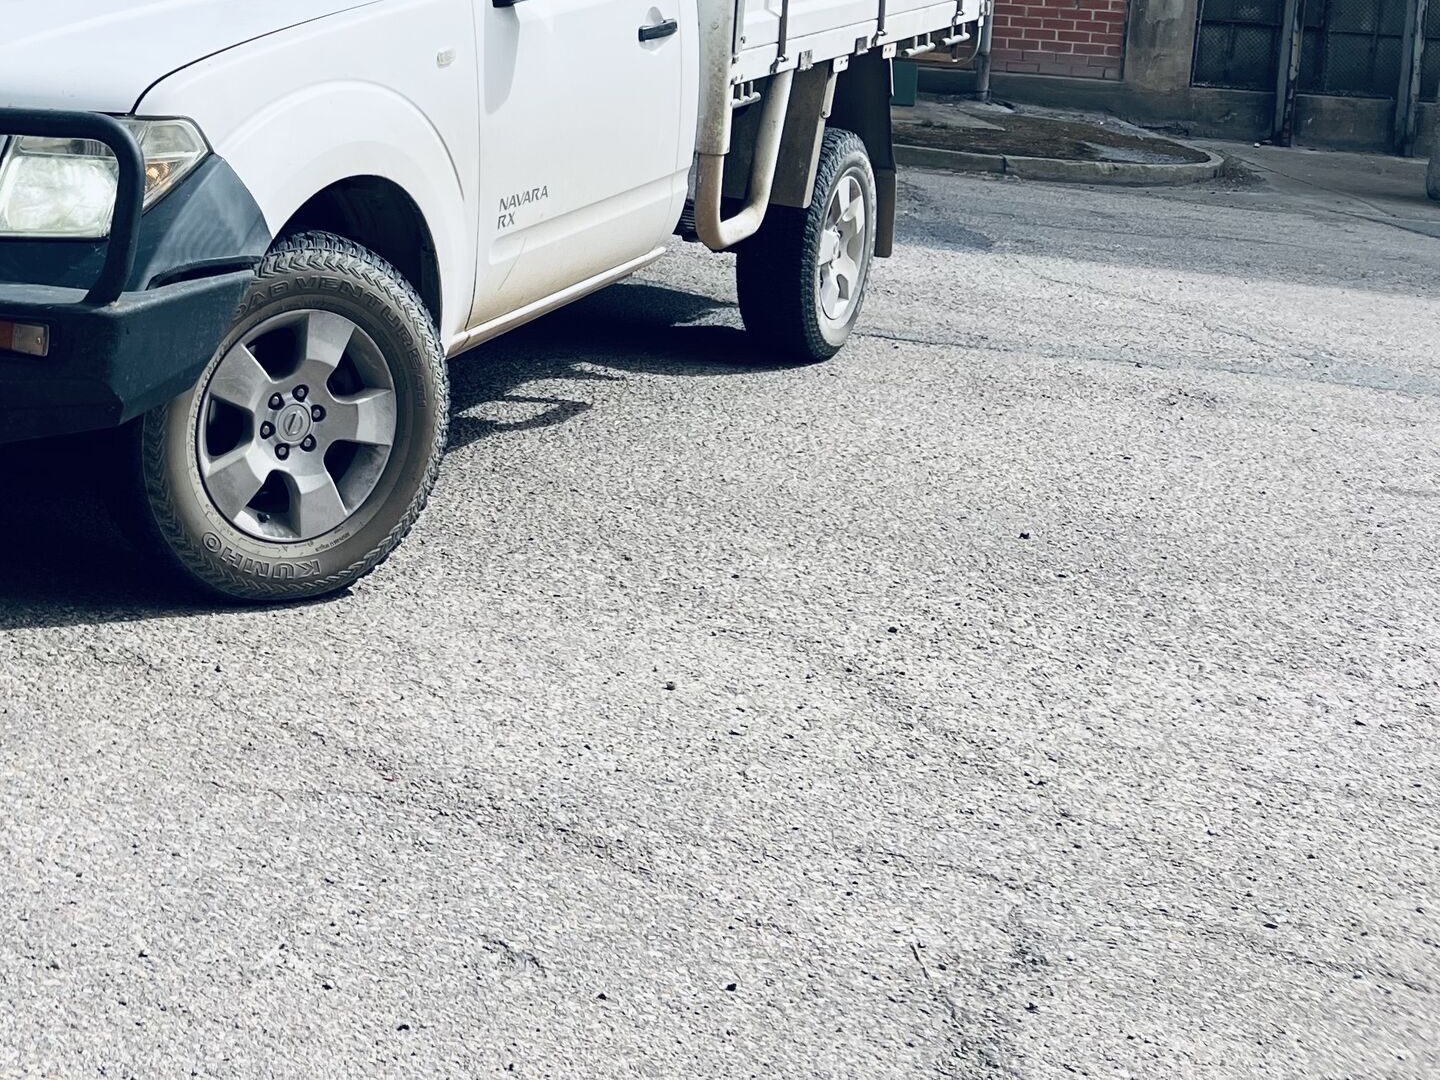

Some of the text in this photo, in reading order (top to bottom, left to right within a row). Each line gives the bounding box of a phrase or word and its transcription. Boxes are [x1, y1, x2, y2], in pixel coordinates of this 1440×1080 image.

[499, 185, 548, 212] NAVARA
[497, 211, 515, 230] RX
[295, 276, 425, 370] VENTURE
[202, 531, 322, 579] KUMHO
